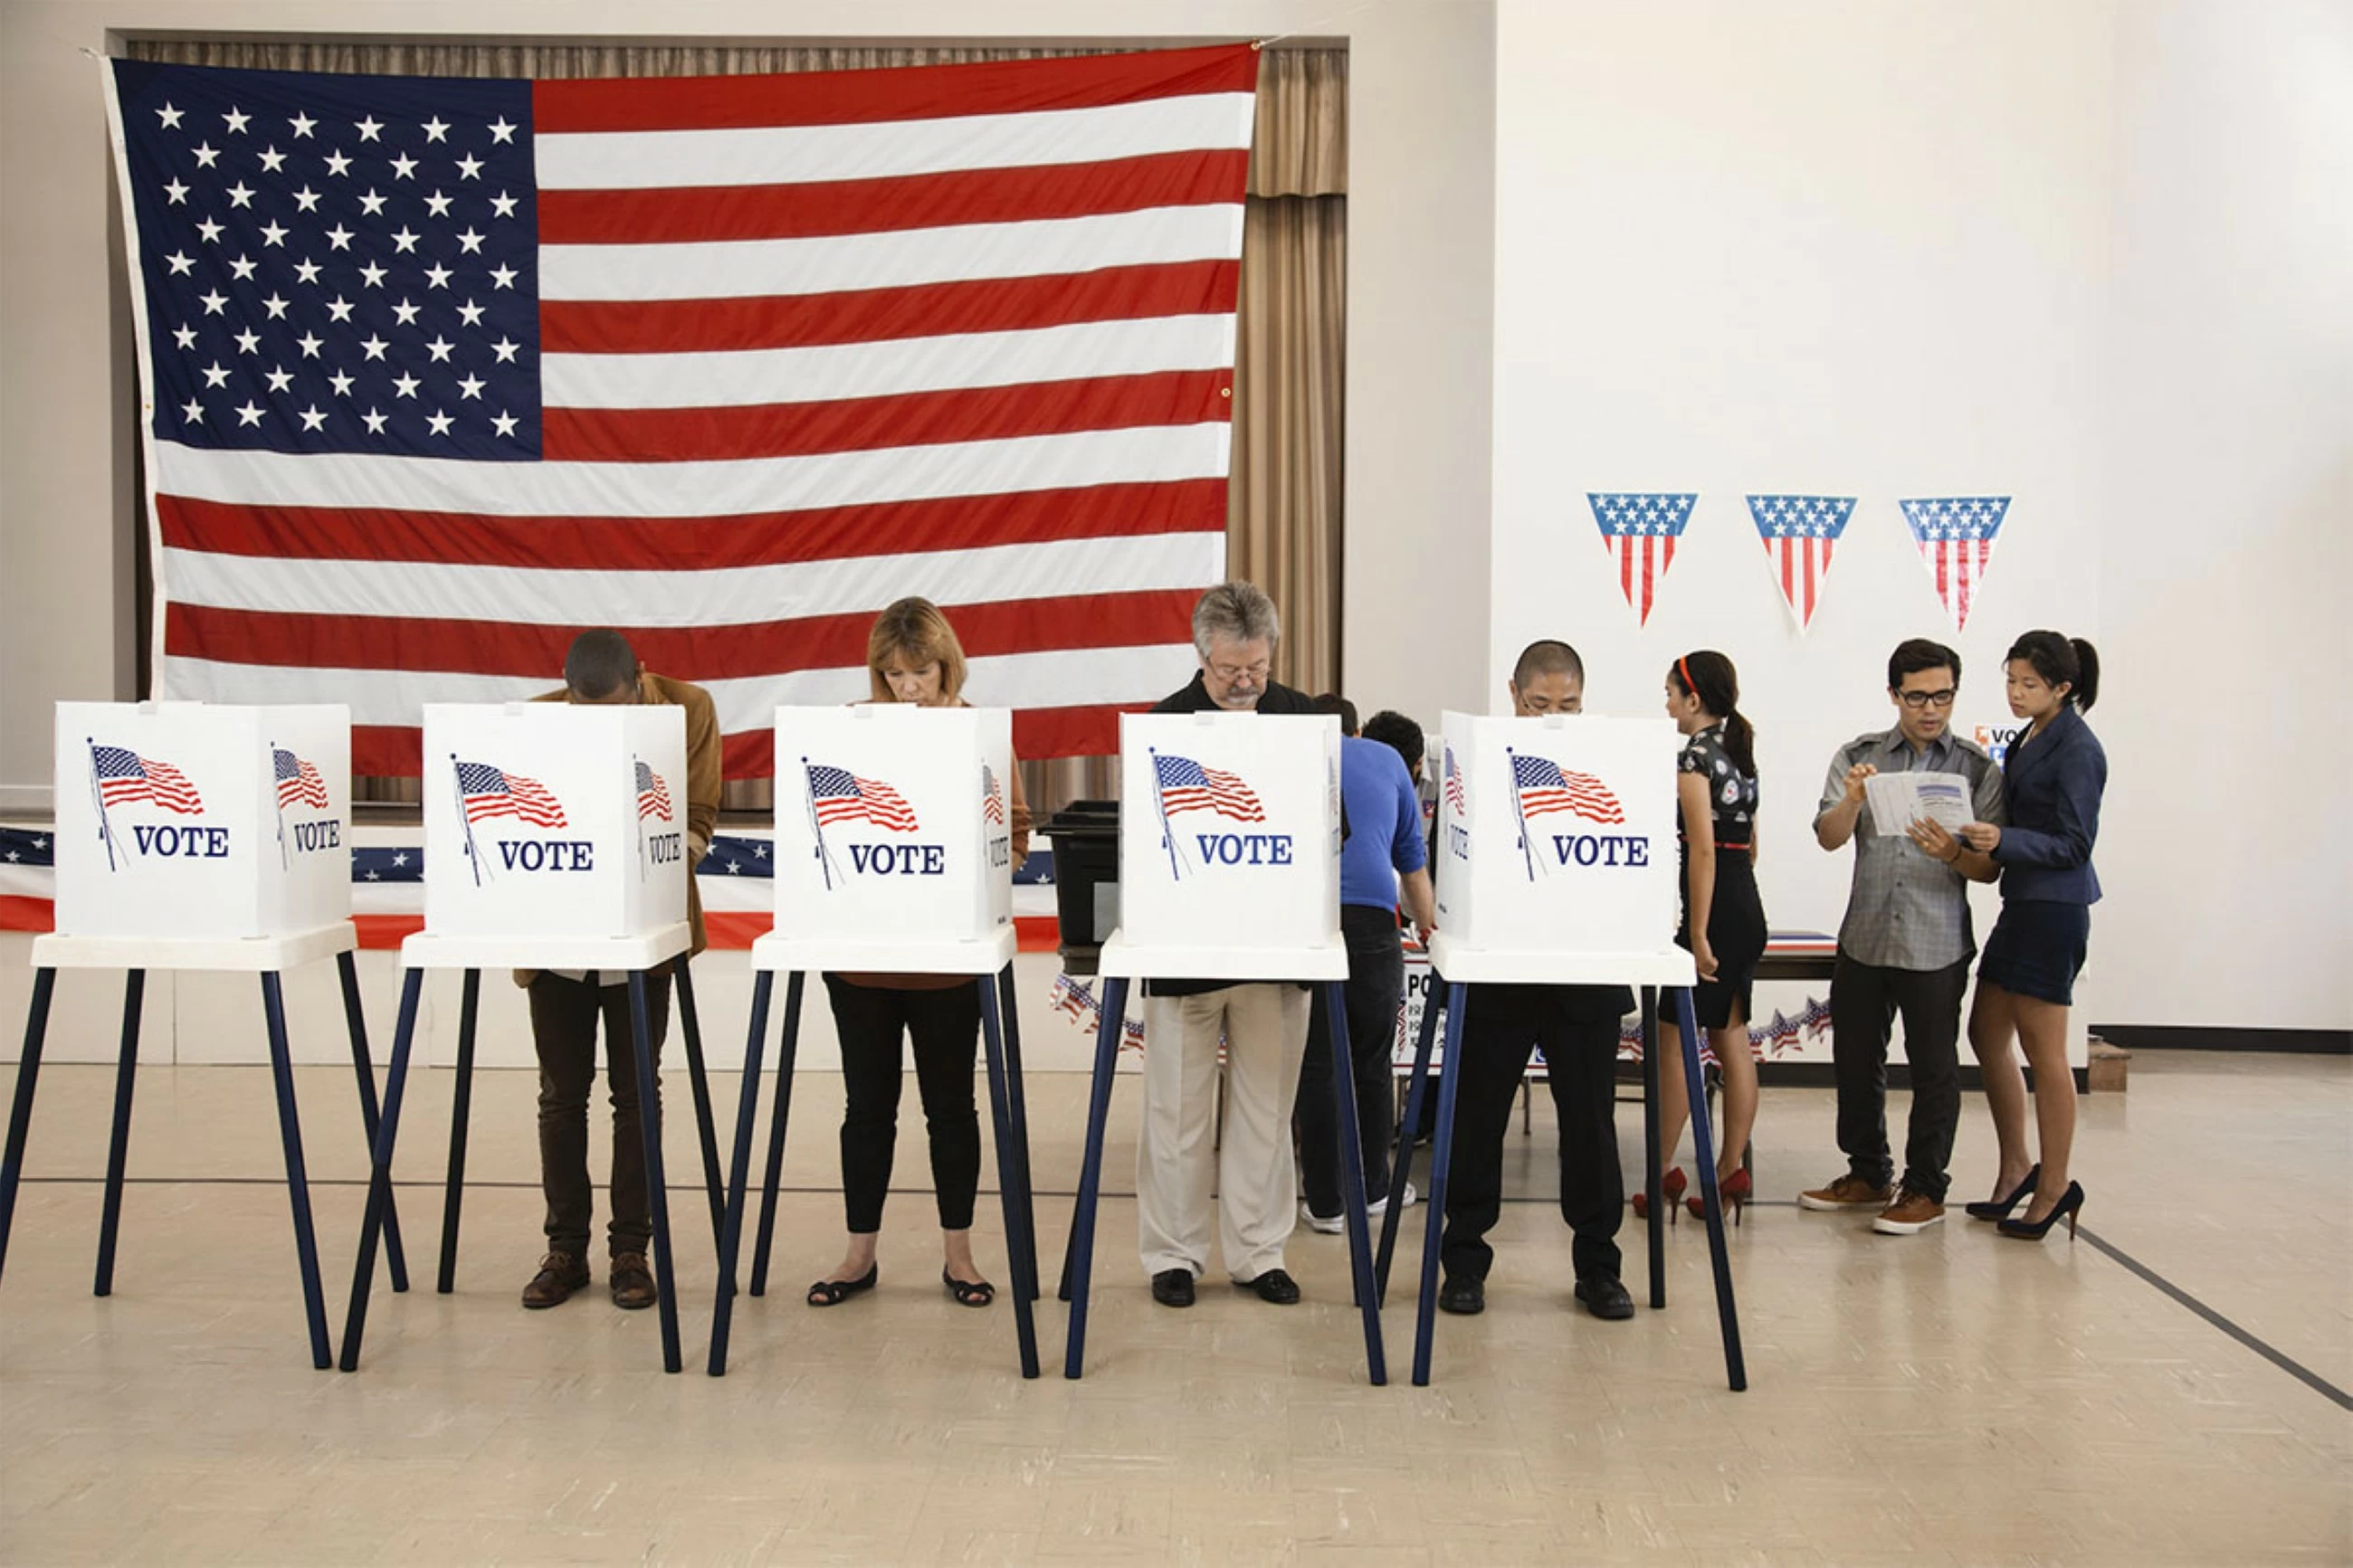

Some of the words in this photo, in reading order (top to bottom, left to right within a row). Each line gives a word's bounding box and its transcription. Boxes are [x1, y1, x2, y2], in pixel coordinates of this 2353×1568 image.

[133, 825, 229, 858] VOTE
[293, 819, 340, 852] VOTE
[649, 832, 681, 865] VOTE
[1196, 833, 1292, 865] VOTE
[1552, 834, 1649, 867] VOTE
[498, 841, 594, 871] VOTE
[848, 844, 945, 875] VOTE
